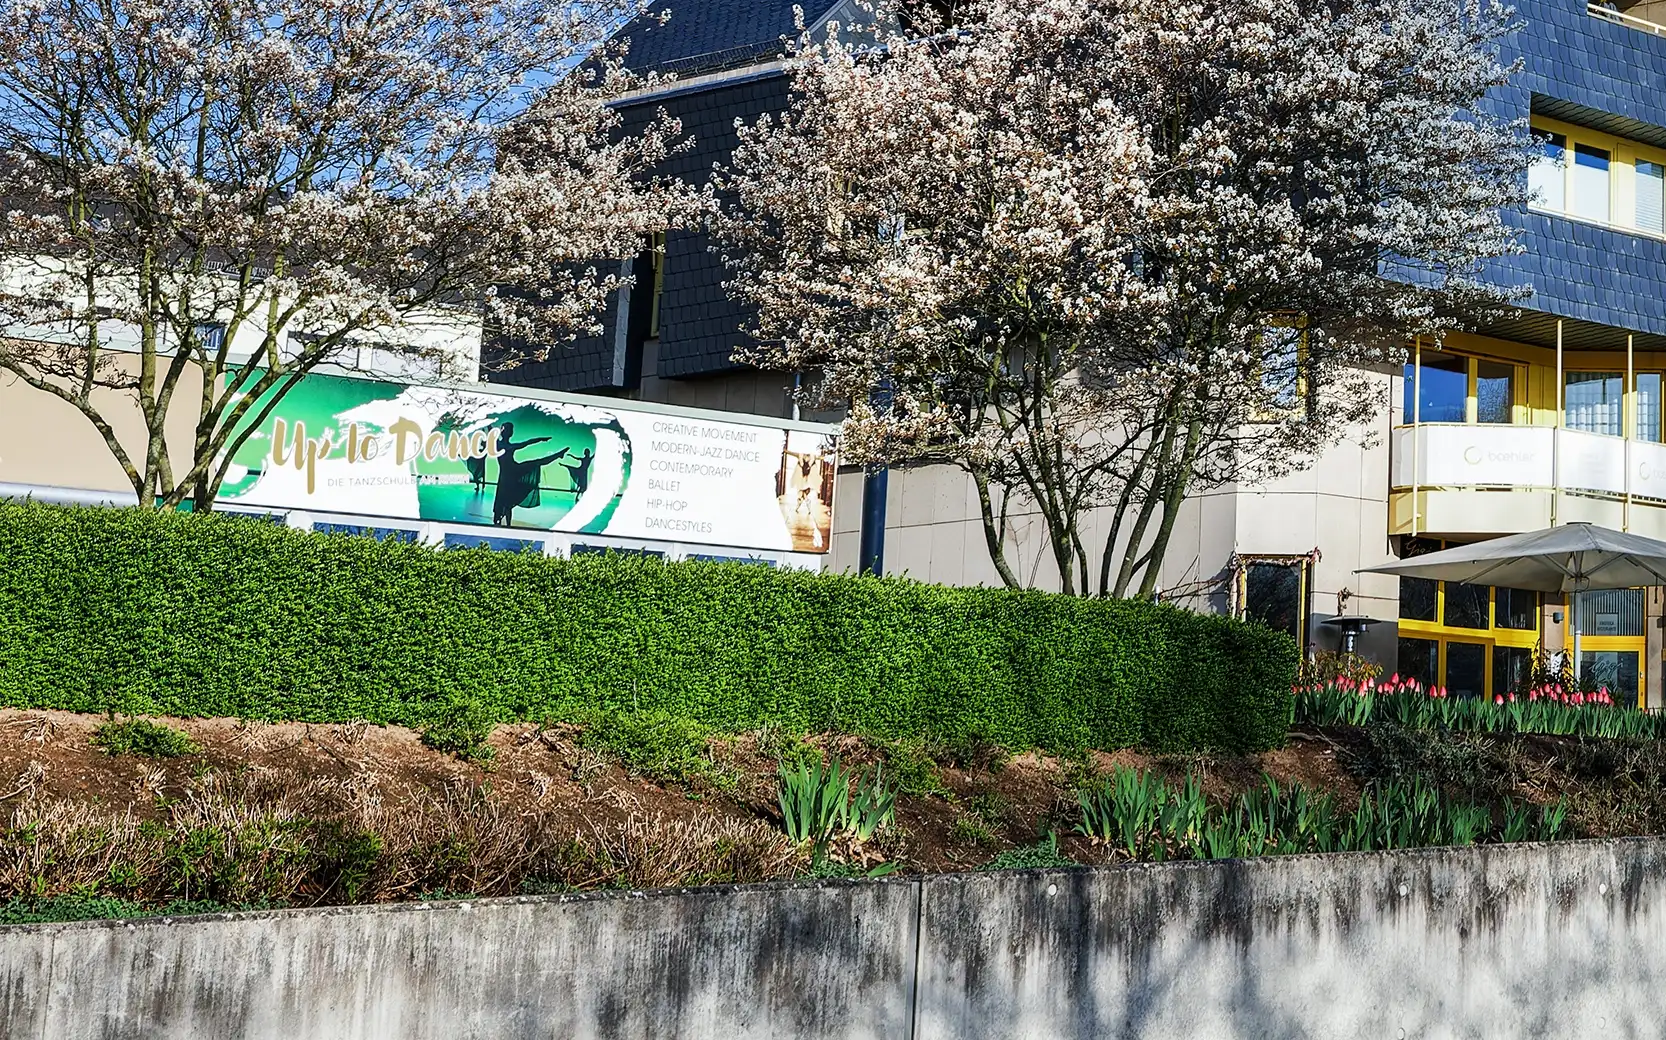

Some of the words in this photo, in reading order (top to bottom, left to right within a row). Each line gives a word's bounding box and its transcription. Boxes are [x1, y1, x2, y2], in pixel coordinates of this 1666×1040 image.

[652, 421, 698, 436] CREATIVE
[701, 427, 757, 442] MOVEMENT
[272, 417, 332, 495] Up
[388, 415, 504, 466] Dance
[651, 440, 722, 458] MODERN-JAZZ
[725, 448, 759, 462] DANCE
[649, 459, 733, 477] CONTEMPORARY
[327, 477, 344, 487] DIE
[648, 478, 681, 492] BALLET
[646, 498, 688, 511] HIP-HOP
[645, 516, 712, 533] DANCESTYLES
